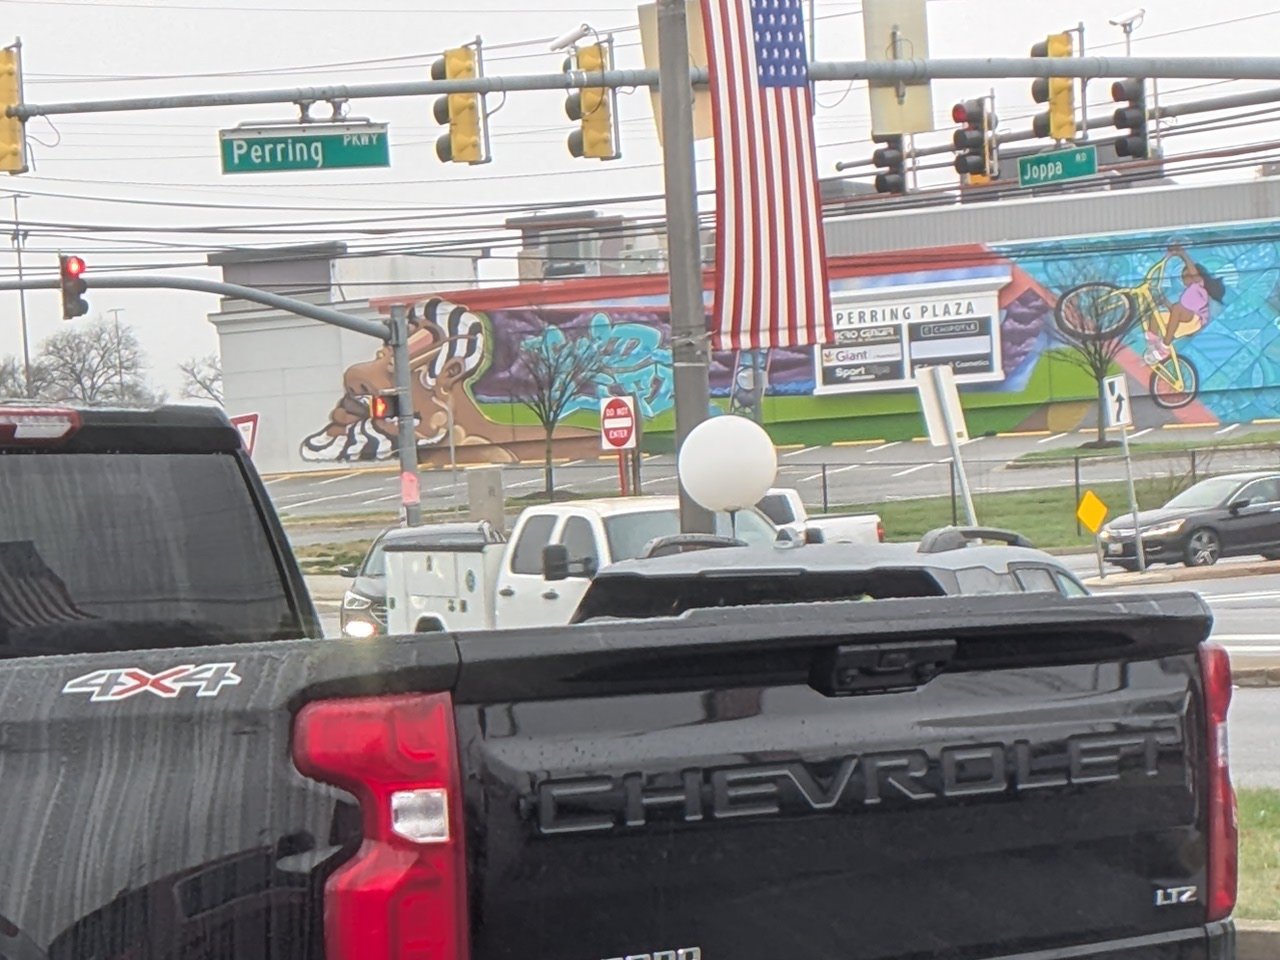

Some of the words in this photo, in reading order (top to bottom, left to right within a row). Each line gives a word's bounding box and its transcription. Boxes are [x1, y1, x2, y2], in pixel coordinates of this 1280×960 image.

[232, 139, 323, 168] Perring
[343, 133, 380, 147] PKWY
[1024, 161, 1063, 180] Joppa
[1075, 153, 1087, 163] RD
[835, 306, 911, 326] PERRING
[920, 301, 975, 318] PLAZA
[933, 322, 976, 334] CHIPOTLE
[835, 349, 868, 362] Giant
[835, 366, 866, 378] Sport
[606, 407, 615, 416] DO
[616, 406, 629, 416] NOT
[609, 429, 628, 439] ENTER
[536, 726, 1183, 835] CHEVROLET
[1156, 885, 1198, 906] LTZ
